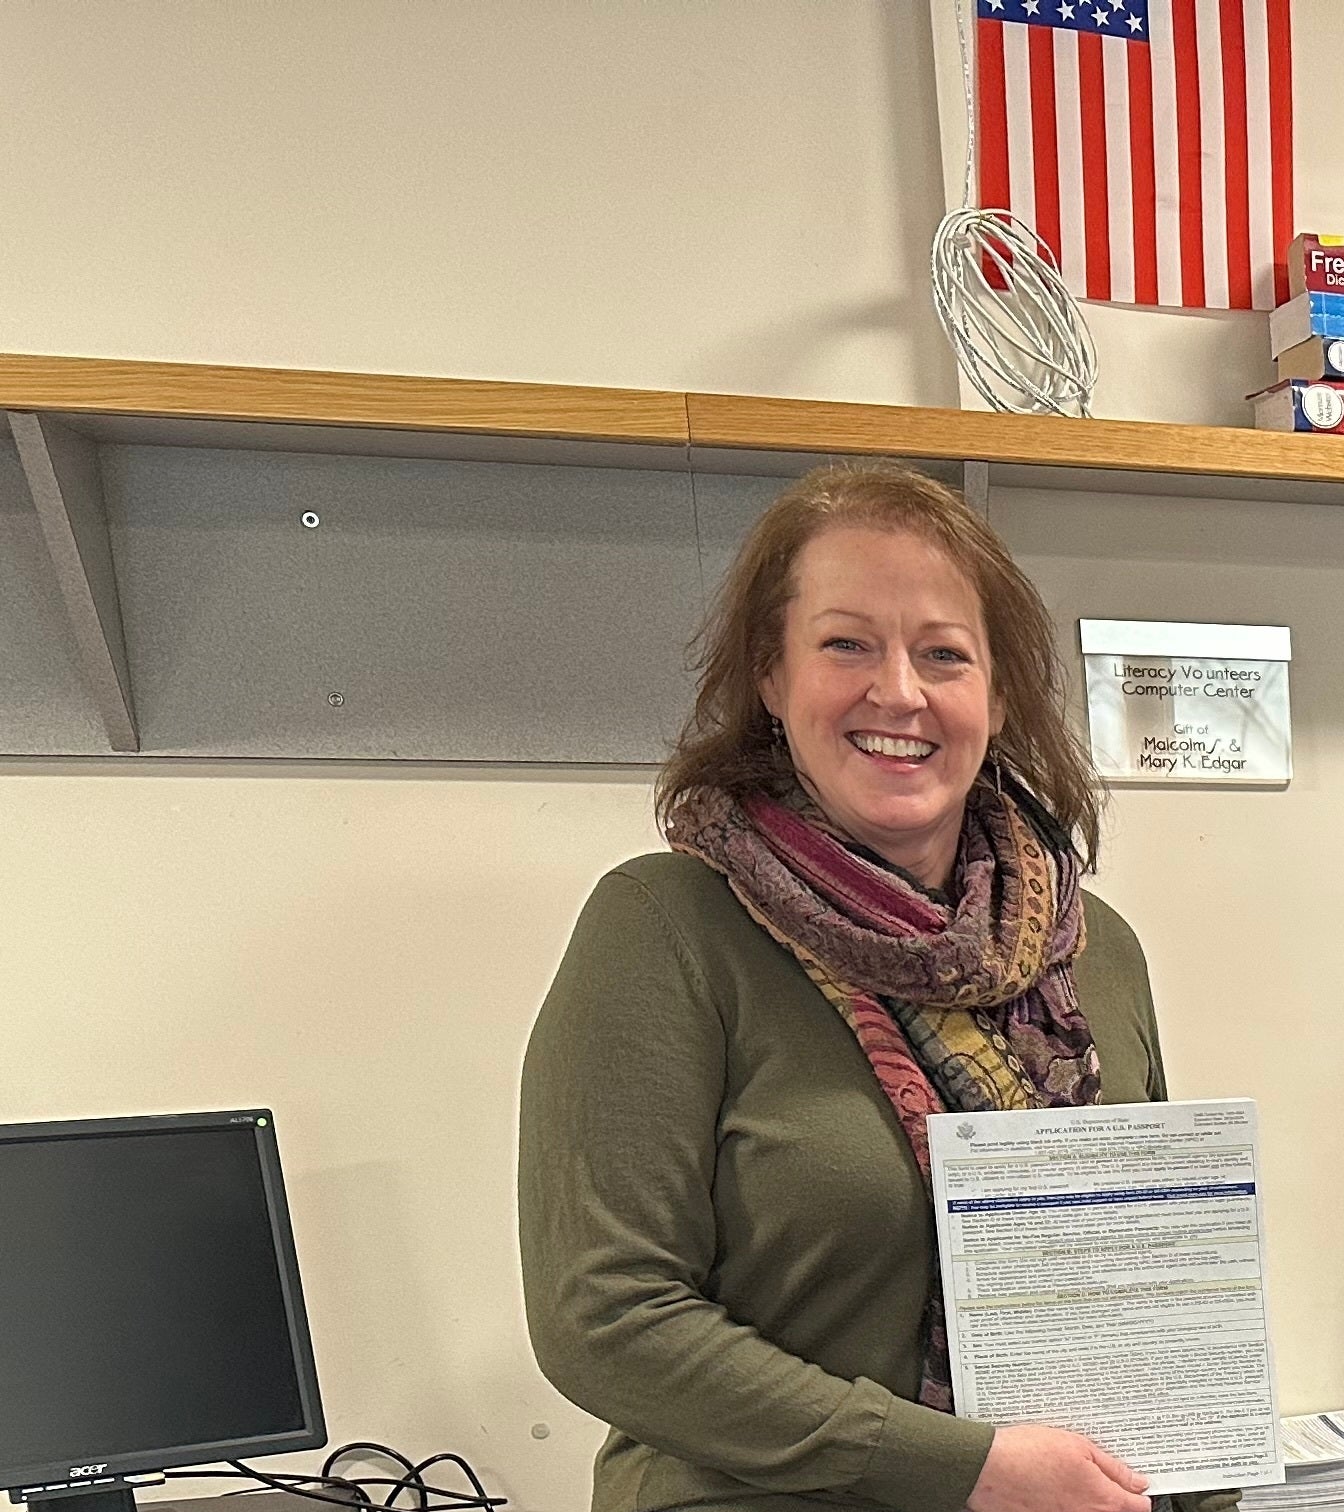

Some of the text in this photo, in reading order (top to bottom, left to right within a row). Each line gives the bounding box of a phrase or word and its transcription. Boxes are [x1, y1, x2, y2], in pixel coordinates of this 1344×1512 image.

[1113, 663, 1261, 682] Literacy Vounteers
[1121, 681, 1256, 700] Computer Center
[1174, 724, 1209, 735] Gift of
[1144, 736, 1241, 752] Malcolm &
[1140, 754, 1177, 773] Mary
[1200, 756, 1248, 773] Edgar
[1035, 1126, 1087, 1135] APPLICATION
[1127, 1123, 1166, 1131] PASSPORT
[69, 1464, 108, 1478] acer
